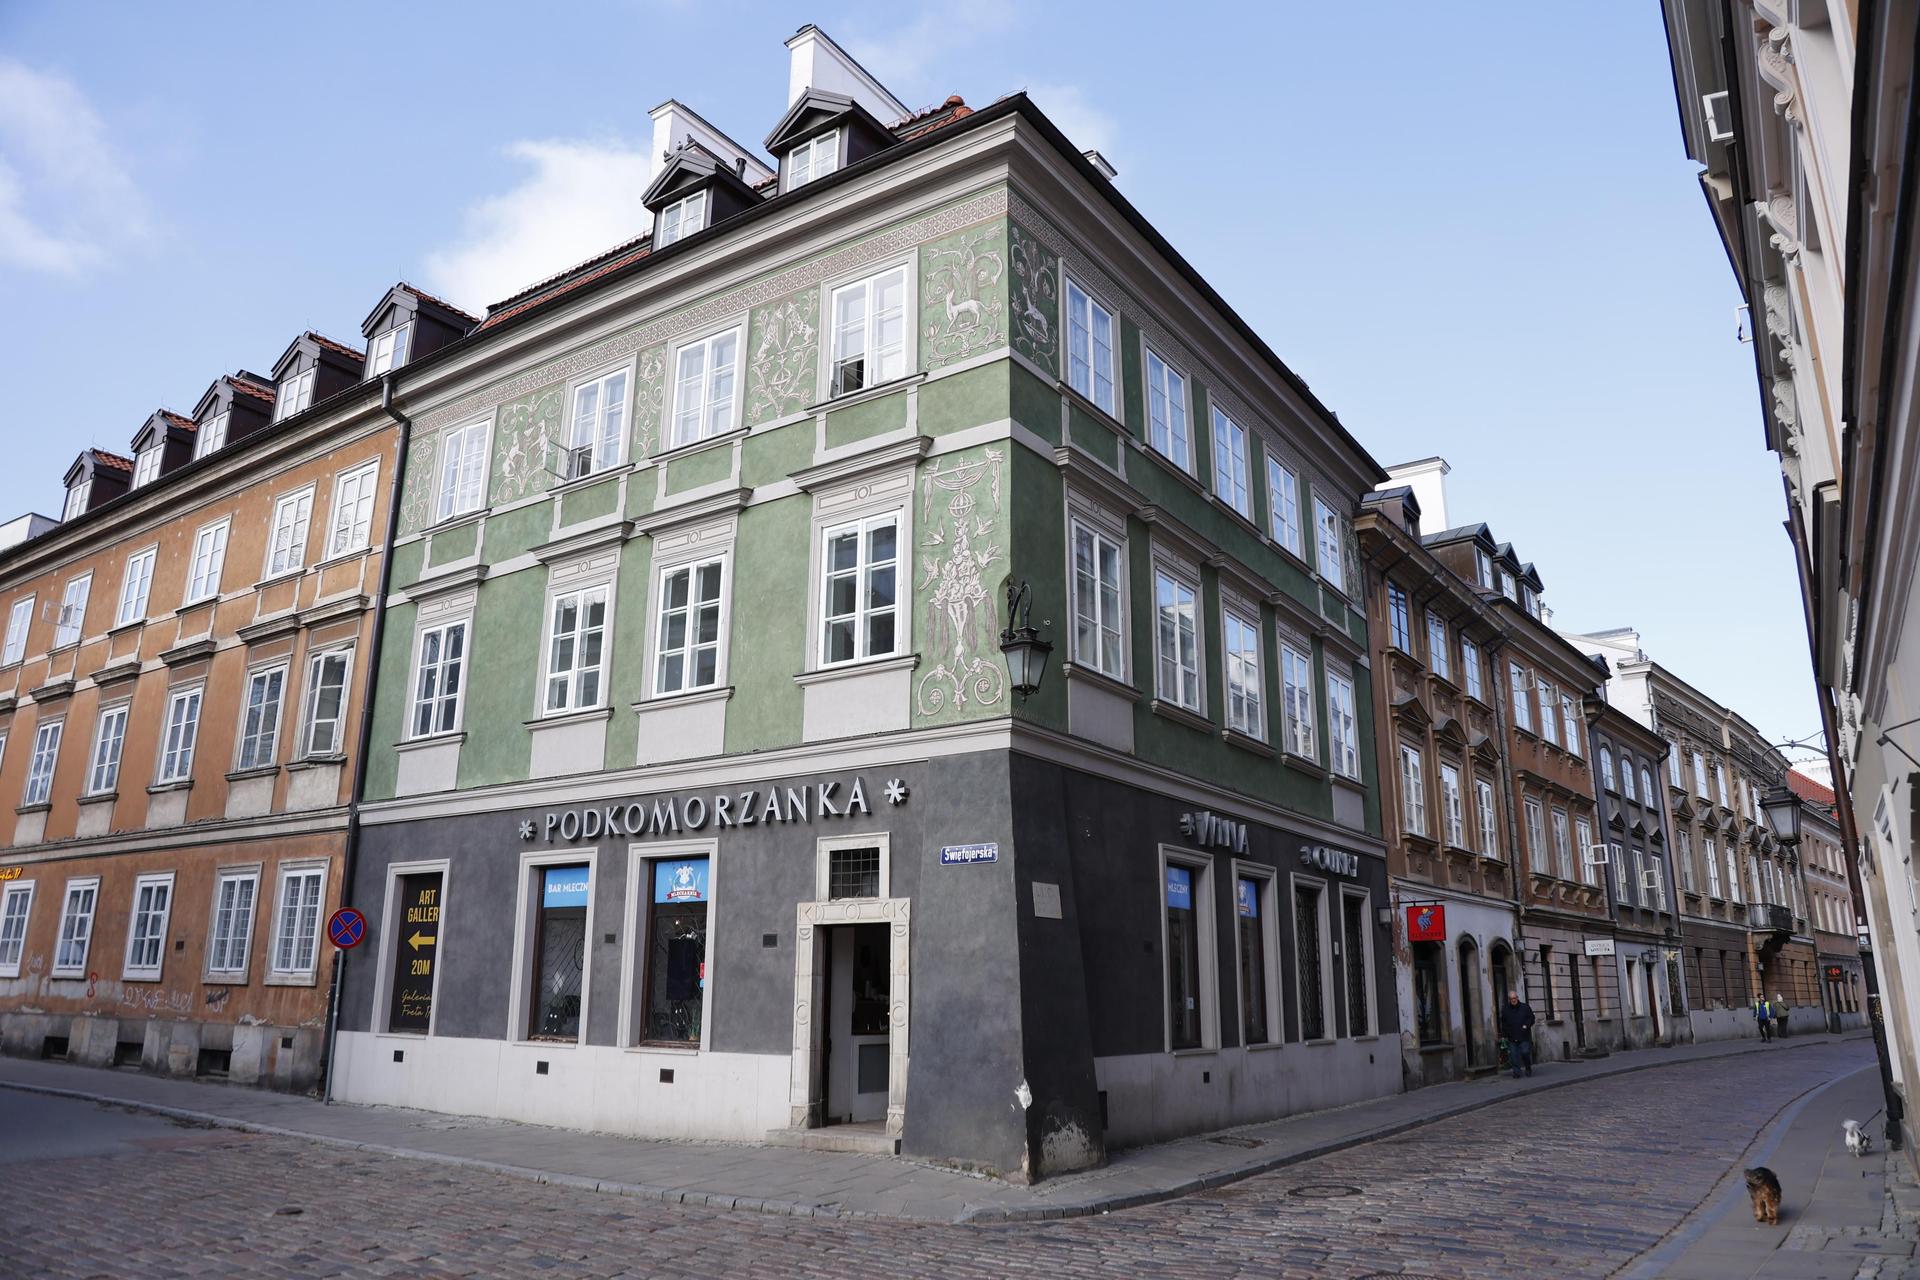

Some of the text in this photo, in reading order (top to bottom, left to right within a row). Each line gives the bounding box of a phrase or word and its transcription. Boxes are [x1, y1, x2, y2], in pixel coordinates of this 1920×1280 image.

[544, 776, 872, 842] PODKOMORZANKA
[548, 881, 589, 894] BAR MLECZN
[419, 889, 436, 905] ART
[411, 959, 431, 975] 20M
[402, 1004, 422, 1017] Freta
